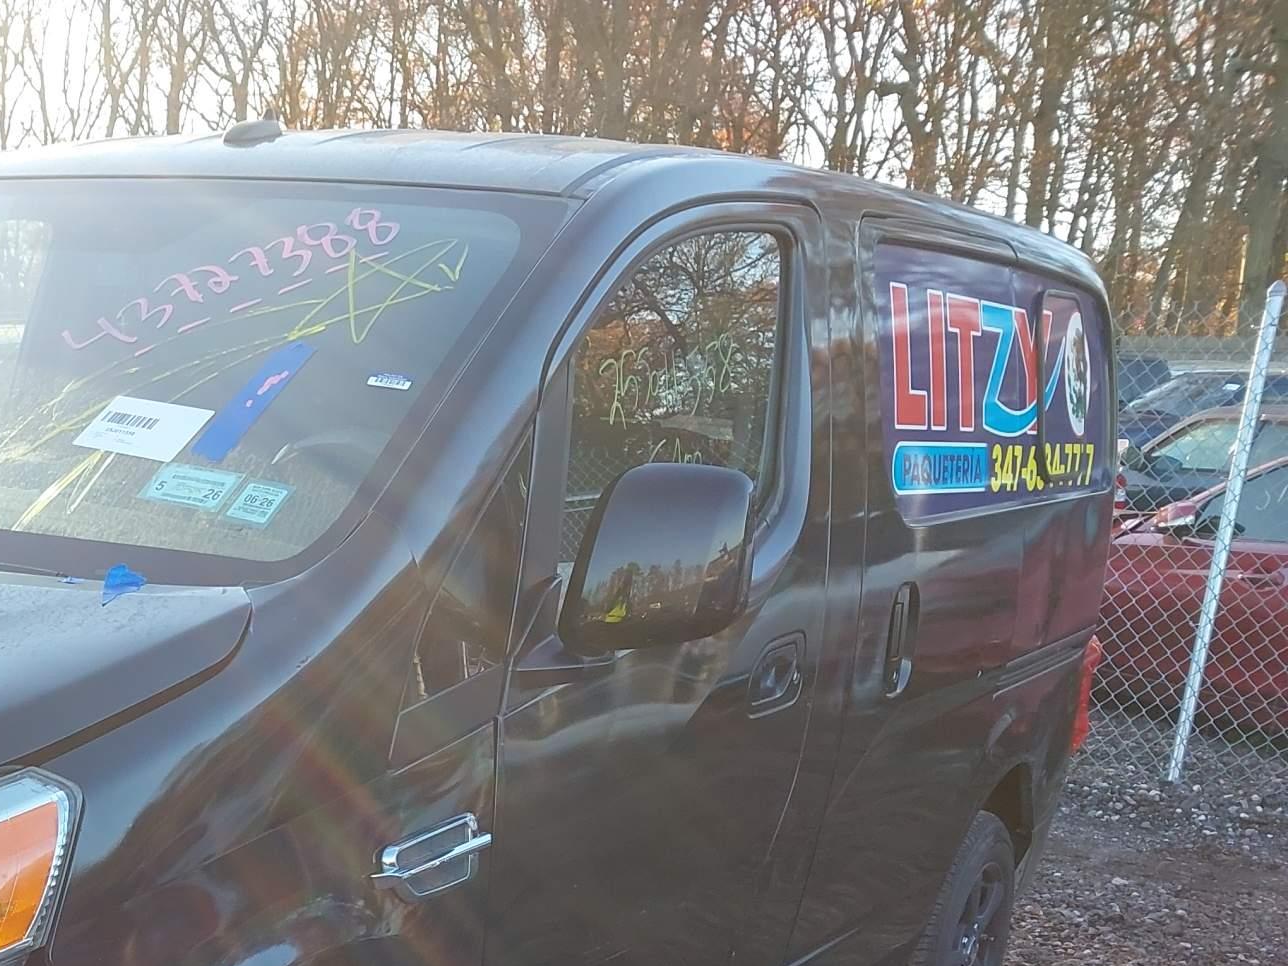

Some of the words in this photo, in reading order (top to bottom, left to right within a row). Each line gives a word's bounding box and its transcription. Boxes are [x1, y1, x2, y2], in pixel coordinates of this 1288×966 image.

[61, 207, 401, 349] 43727388
[889, 281, 1065, 437] LITZY
[155, 480, 167, 491] 5
[202, 488, 223, 501] 26
